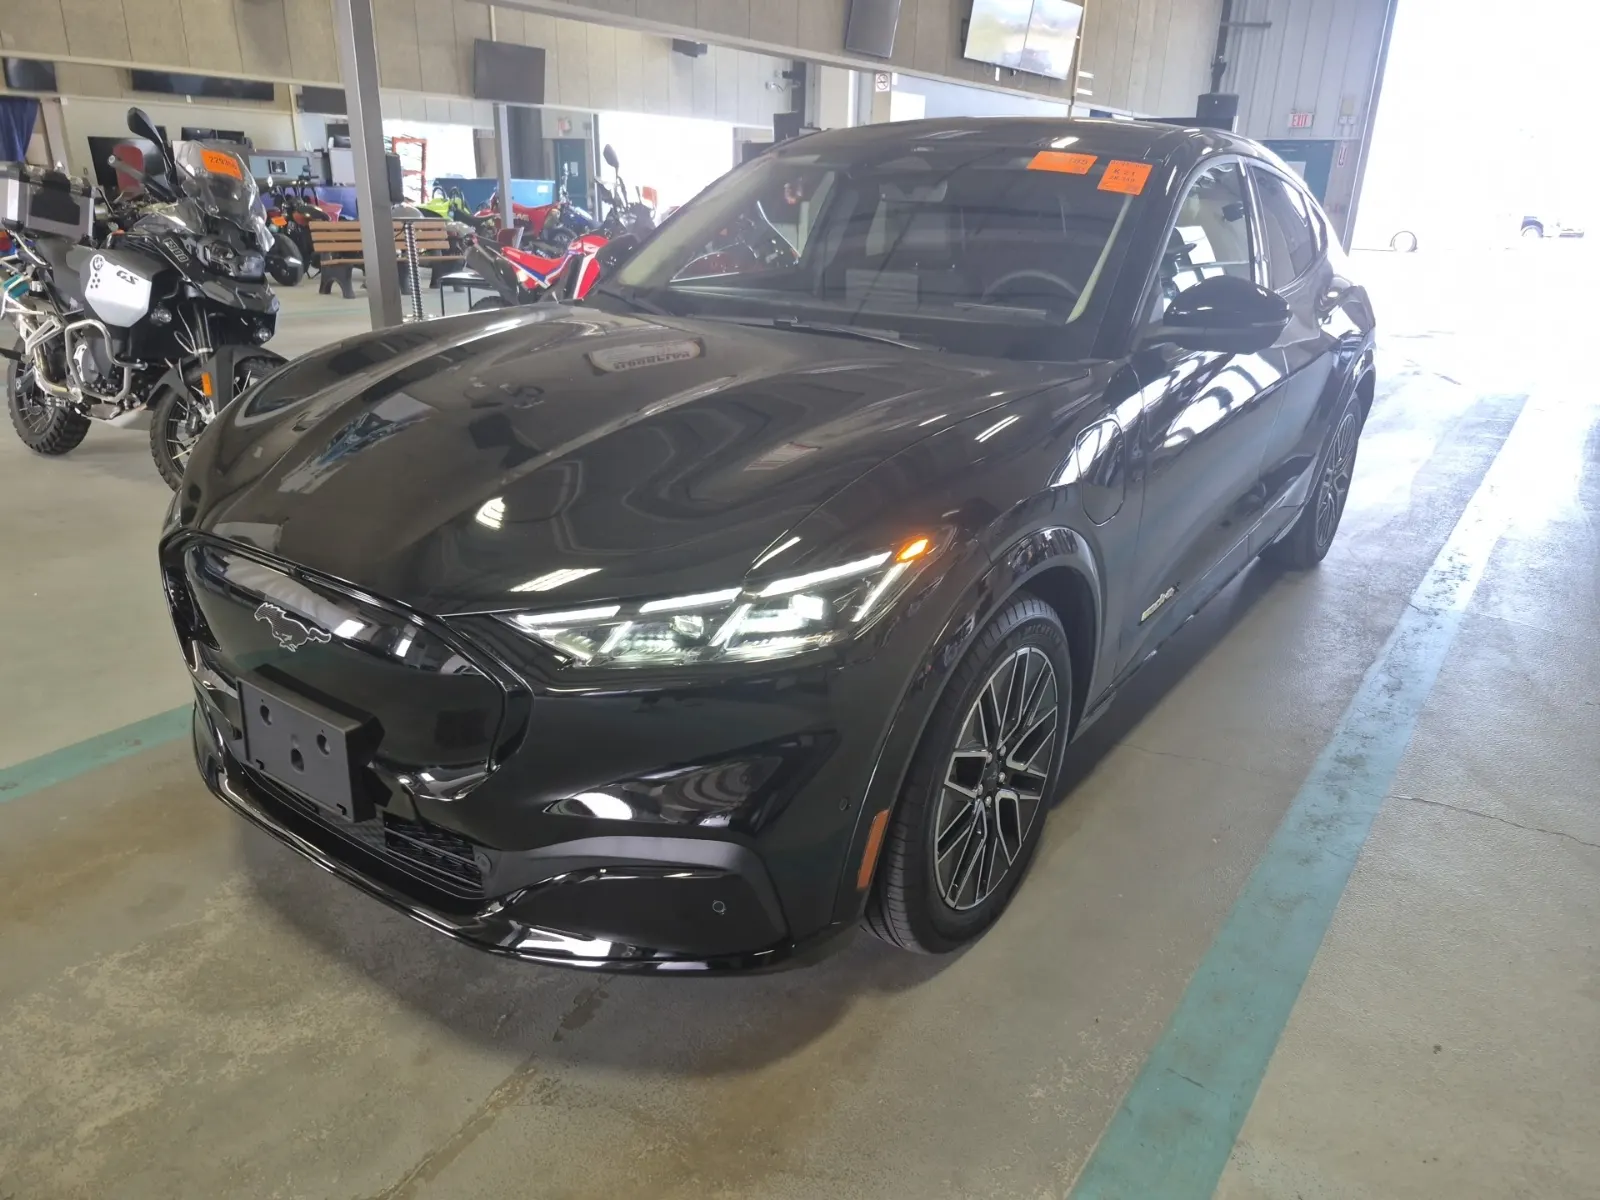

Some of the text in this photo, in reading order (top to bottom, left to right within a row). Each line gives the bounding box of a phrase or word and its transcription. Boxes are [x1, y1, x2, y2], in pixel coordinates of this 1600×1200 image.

[1291, 114, 1309, 126] EXIT
[163, 238, 189, 262] F900
[116, 270, 139, 285] GS
